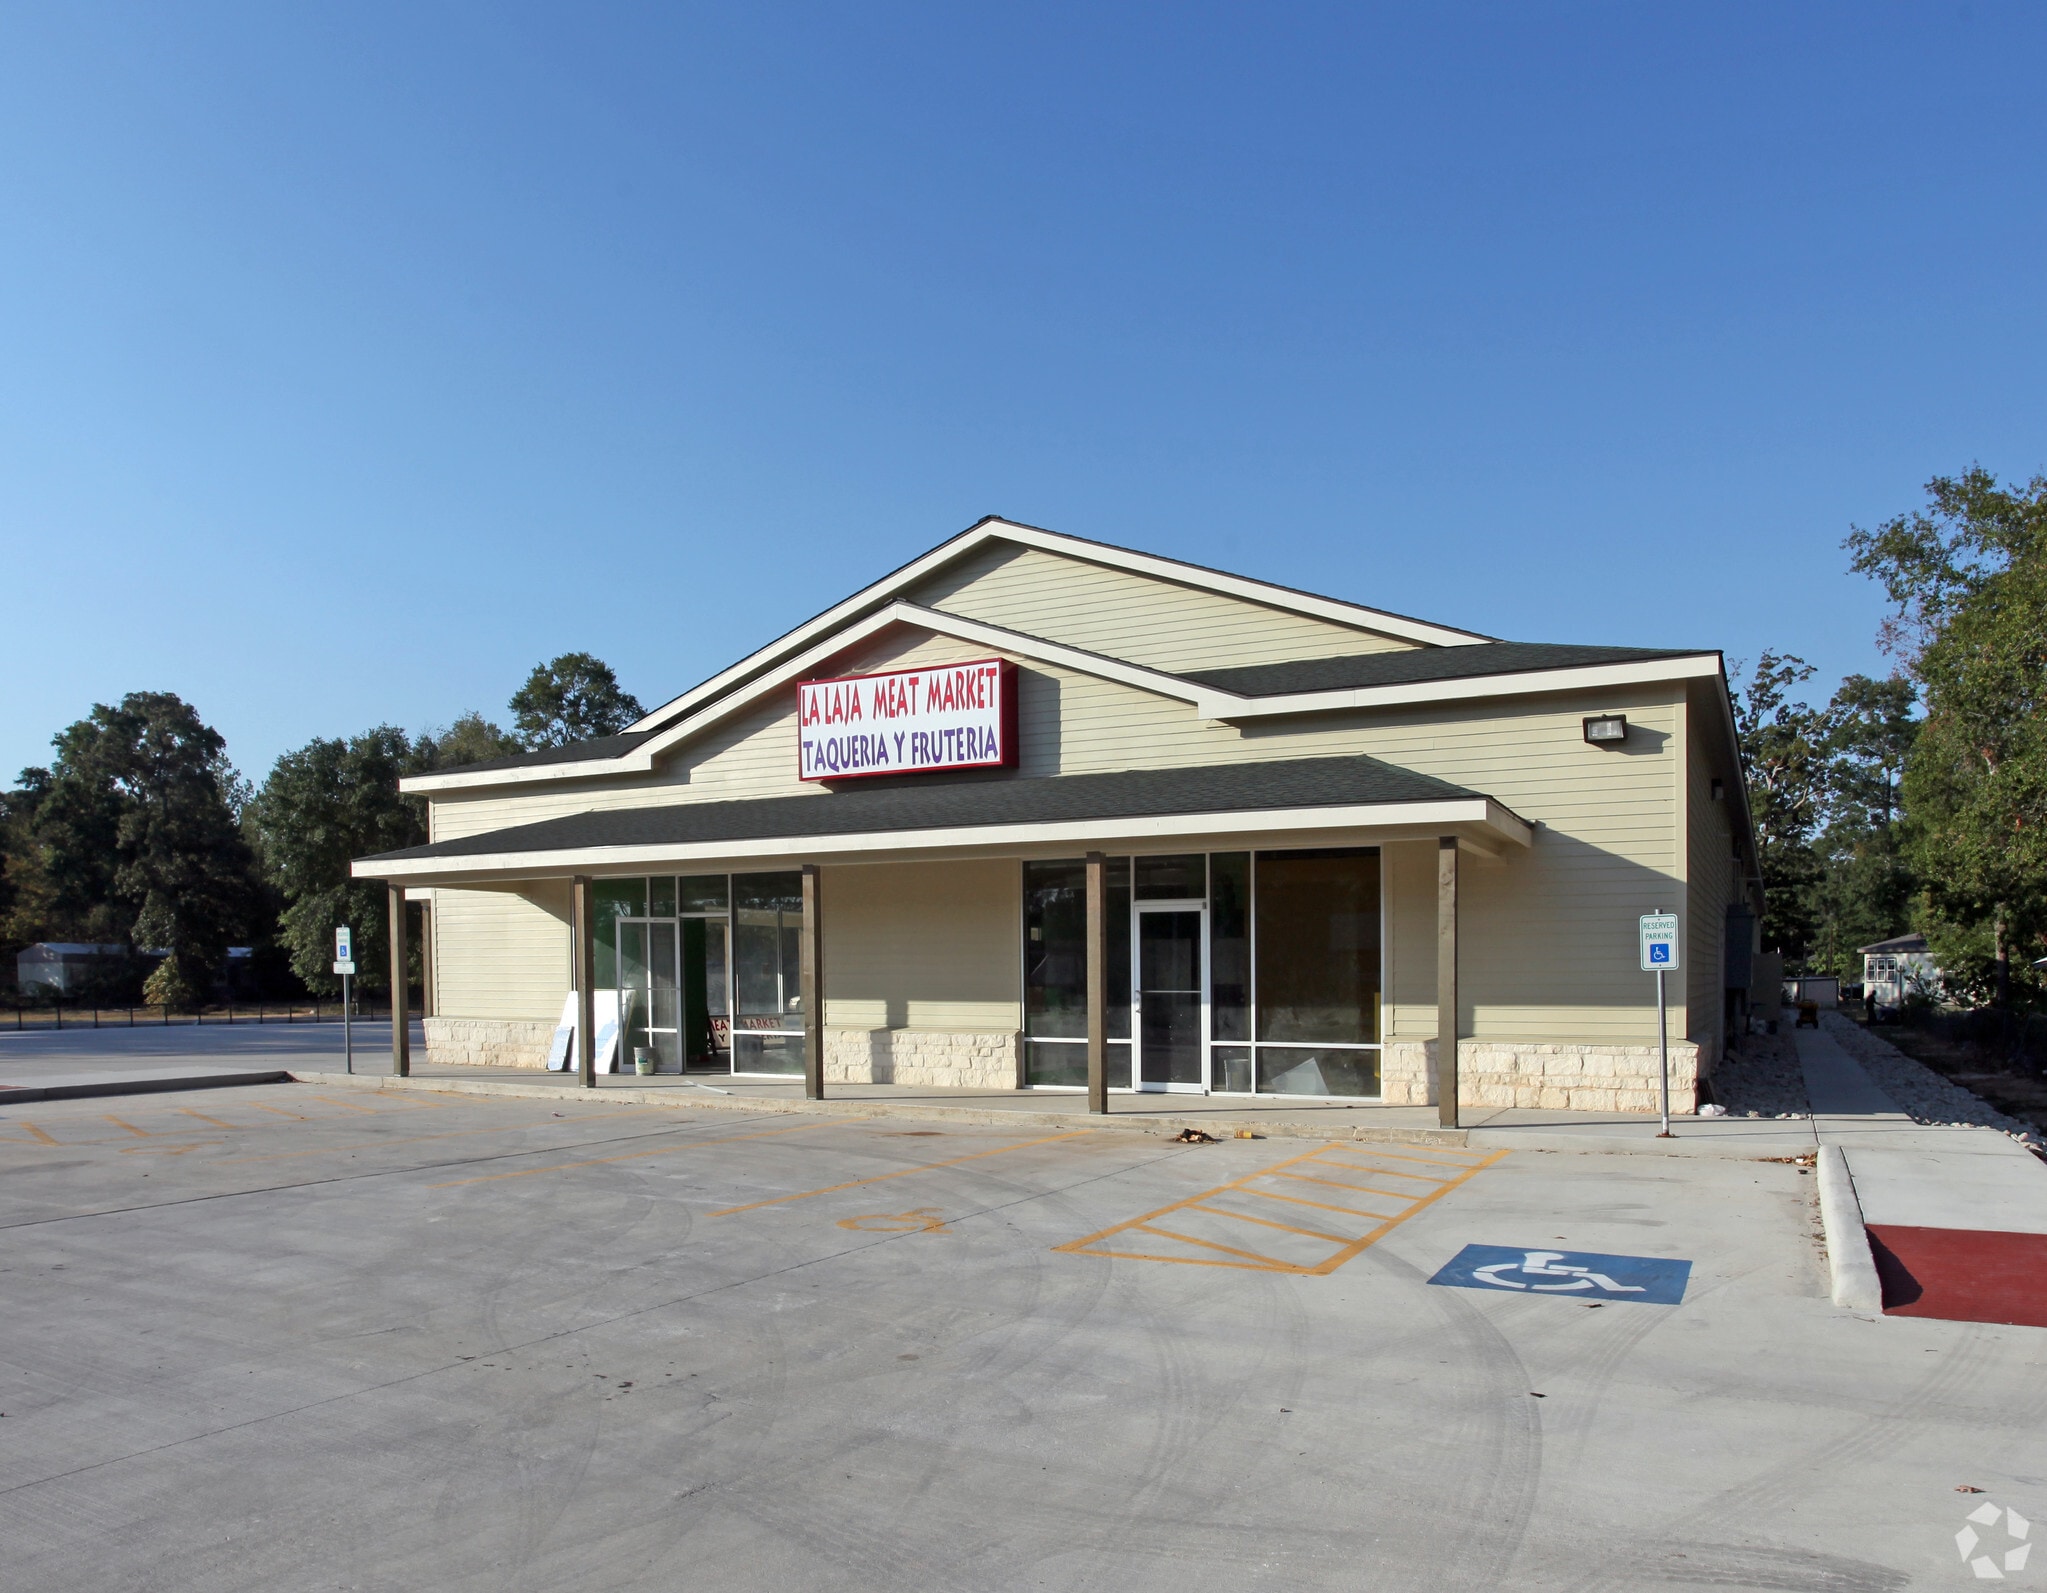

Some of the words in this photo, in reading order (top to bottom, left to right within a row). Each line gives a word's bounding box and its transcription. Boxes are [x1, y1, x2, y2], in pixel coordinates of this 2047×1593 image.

[802, 687, 821, 727] LA
[825, 681, 862, 727] LAJA
[872, 676, 919, 720] MEAT
[926, 667, 997, 714] MARKET
[803, 732, 889, 773] TAQUERIA
[894, 730, 905, 763] Y
[911, 724, 998, 765] FRUTERIA
[1643, 921, 1674, 929] RESERVED
[1645, 932, 1673, 940] PARKING
